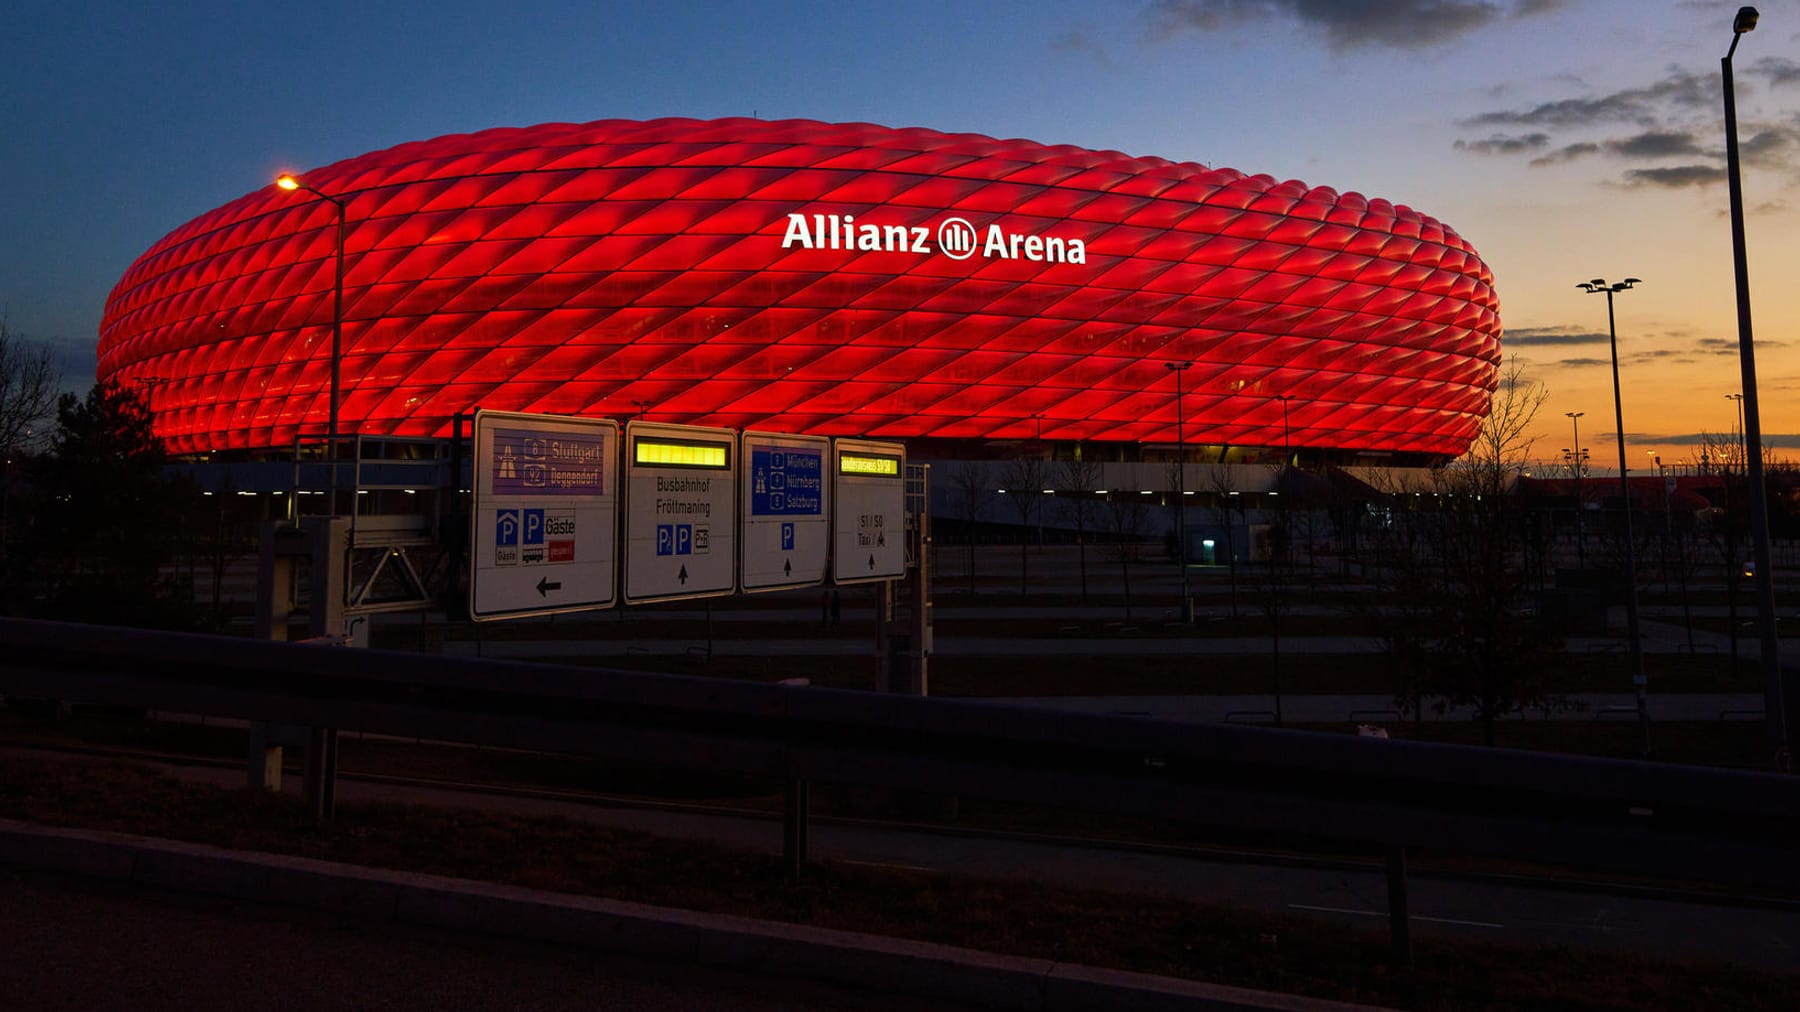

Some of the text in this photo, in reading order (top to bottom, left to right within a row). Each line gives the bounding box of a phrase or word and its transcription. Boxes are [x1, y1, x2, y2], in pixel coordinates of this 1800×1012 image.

[781, 213, 1087, 265] Allianz Arena
[552, 441, 600, 464] Stuttgart
[551, 467, 600, 488] Deggendorf
[657, 476, 710, 492] Busbahnhof
[656, 498, 710, 518] Fröttmaning
[545, 517, 575, 535] Gäste
